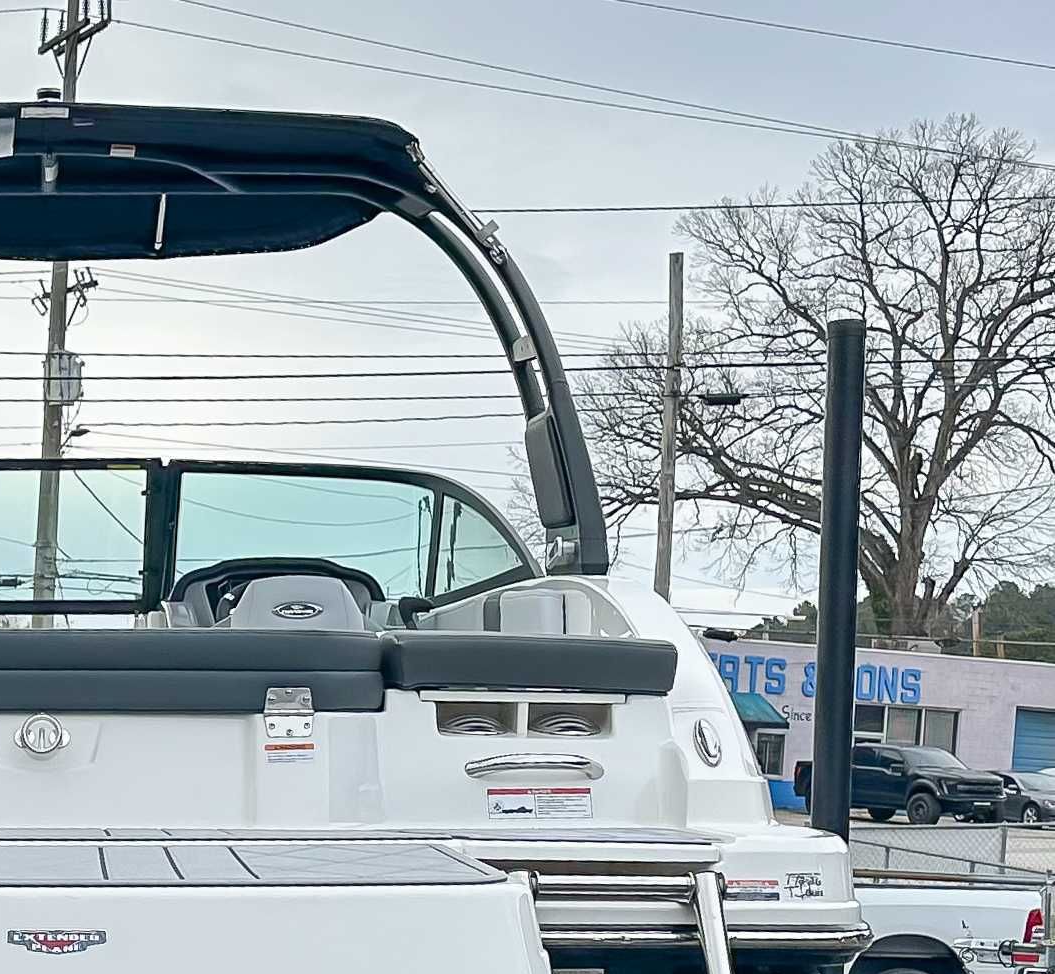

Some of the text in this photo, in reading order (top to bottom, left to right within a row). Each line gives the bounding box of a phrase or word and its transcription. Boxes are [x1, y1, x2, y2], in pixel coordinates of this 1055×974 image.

[709, 652, 786, 695] ATS
[856, 664, 922, 704] ONS
[782, 705, 812, 722] Since
[12, 932, 100, 942] EXTENDED
